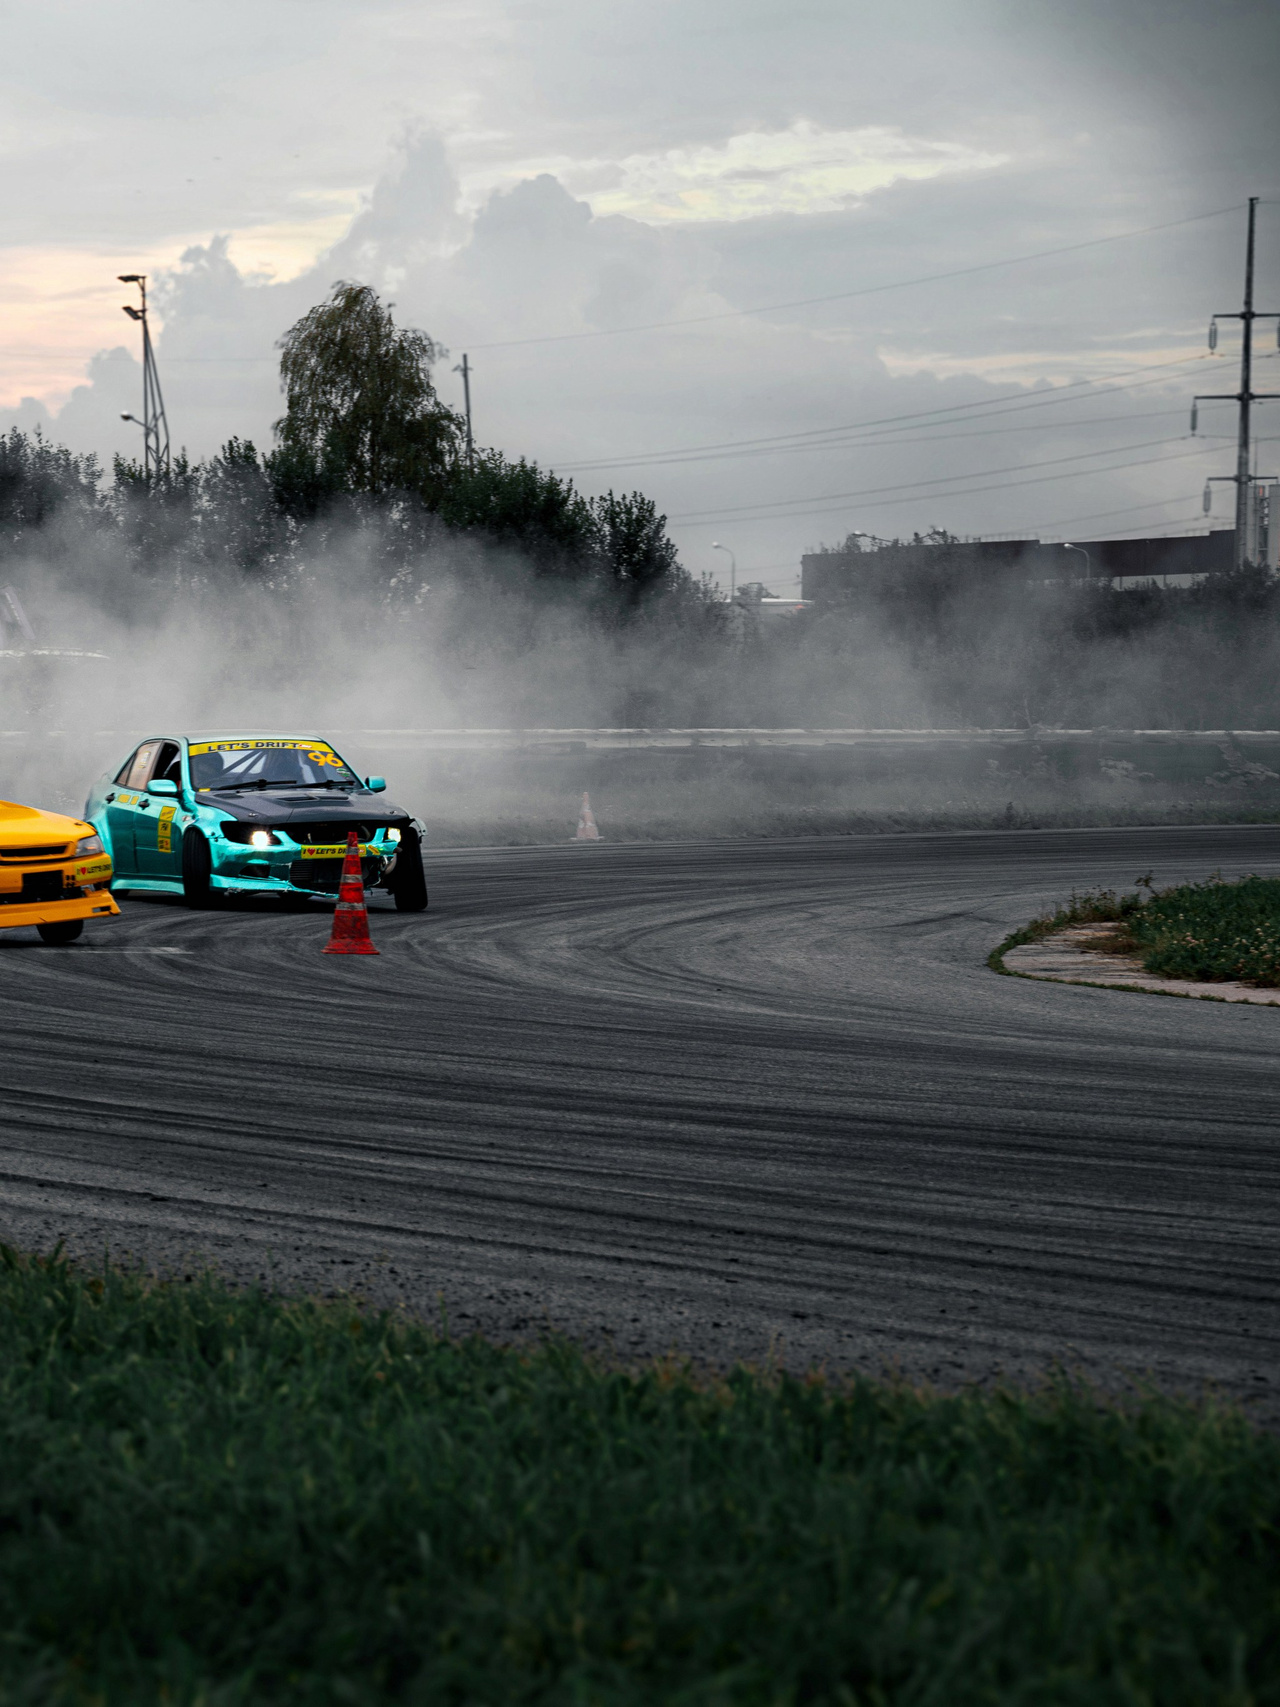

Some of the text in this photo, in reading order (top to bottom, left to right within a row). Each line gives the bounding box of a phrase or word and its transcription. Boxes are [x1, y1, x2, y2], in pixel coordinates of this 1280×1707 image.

[208, 742, 250, 752] LET'S
[255, 741, 299, 749] DRIFT
[308, 752, 344, 767] 96
